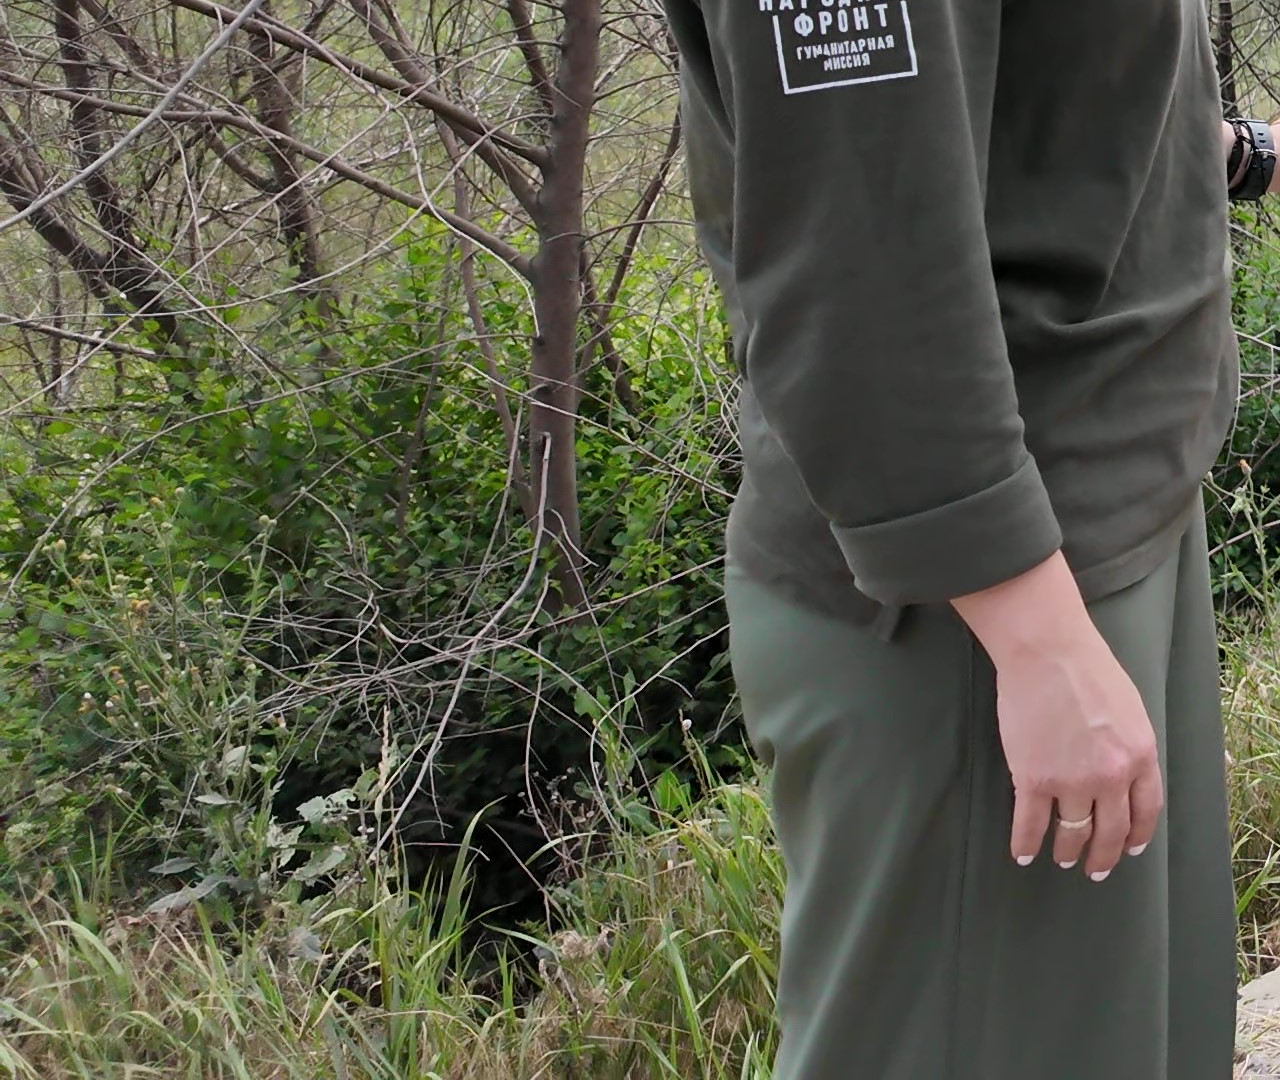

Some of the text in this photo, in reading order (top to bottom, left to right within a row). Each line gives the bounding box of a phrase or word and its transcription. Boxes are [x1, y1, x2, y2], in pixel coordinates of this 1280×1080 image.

[794, 4, 889, 36] ФРОНТ
[796, 34, 895, 60] ГУМАНИТАРНАЯ
[823, 52, 871, 71] МИССИЯ
